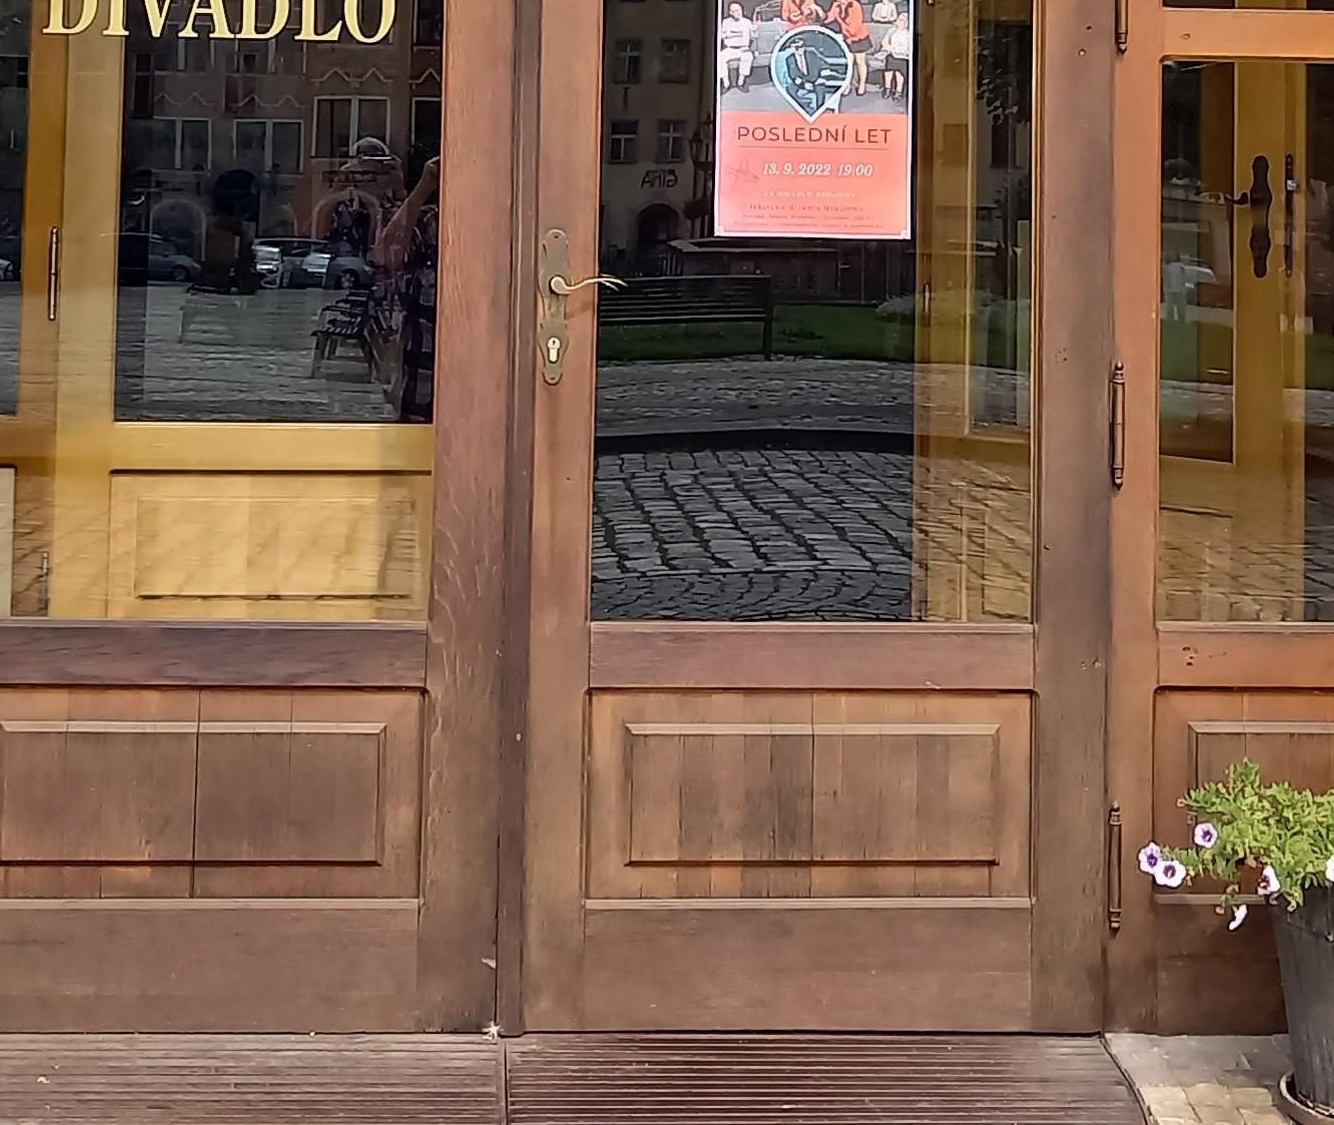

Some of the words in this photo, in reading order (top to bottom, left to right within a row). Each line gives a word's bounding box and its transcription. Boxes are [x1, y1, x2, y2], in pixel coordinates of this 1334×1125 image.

[737, 124, 848, 143] POSLEDNÍ
[854, 128, 893, 145] LET
[797, 162, 832, 176] 2022
